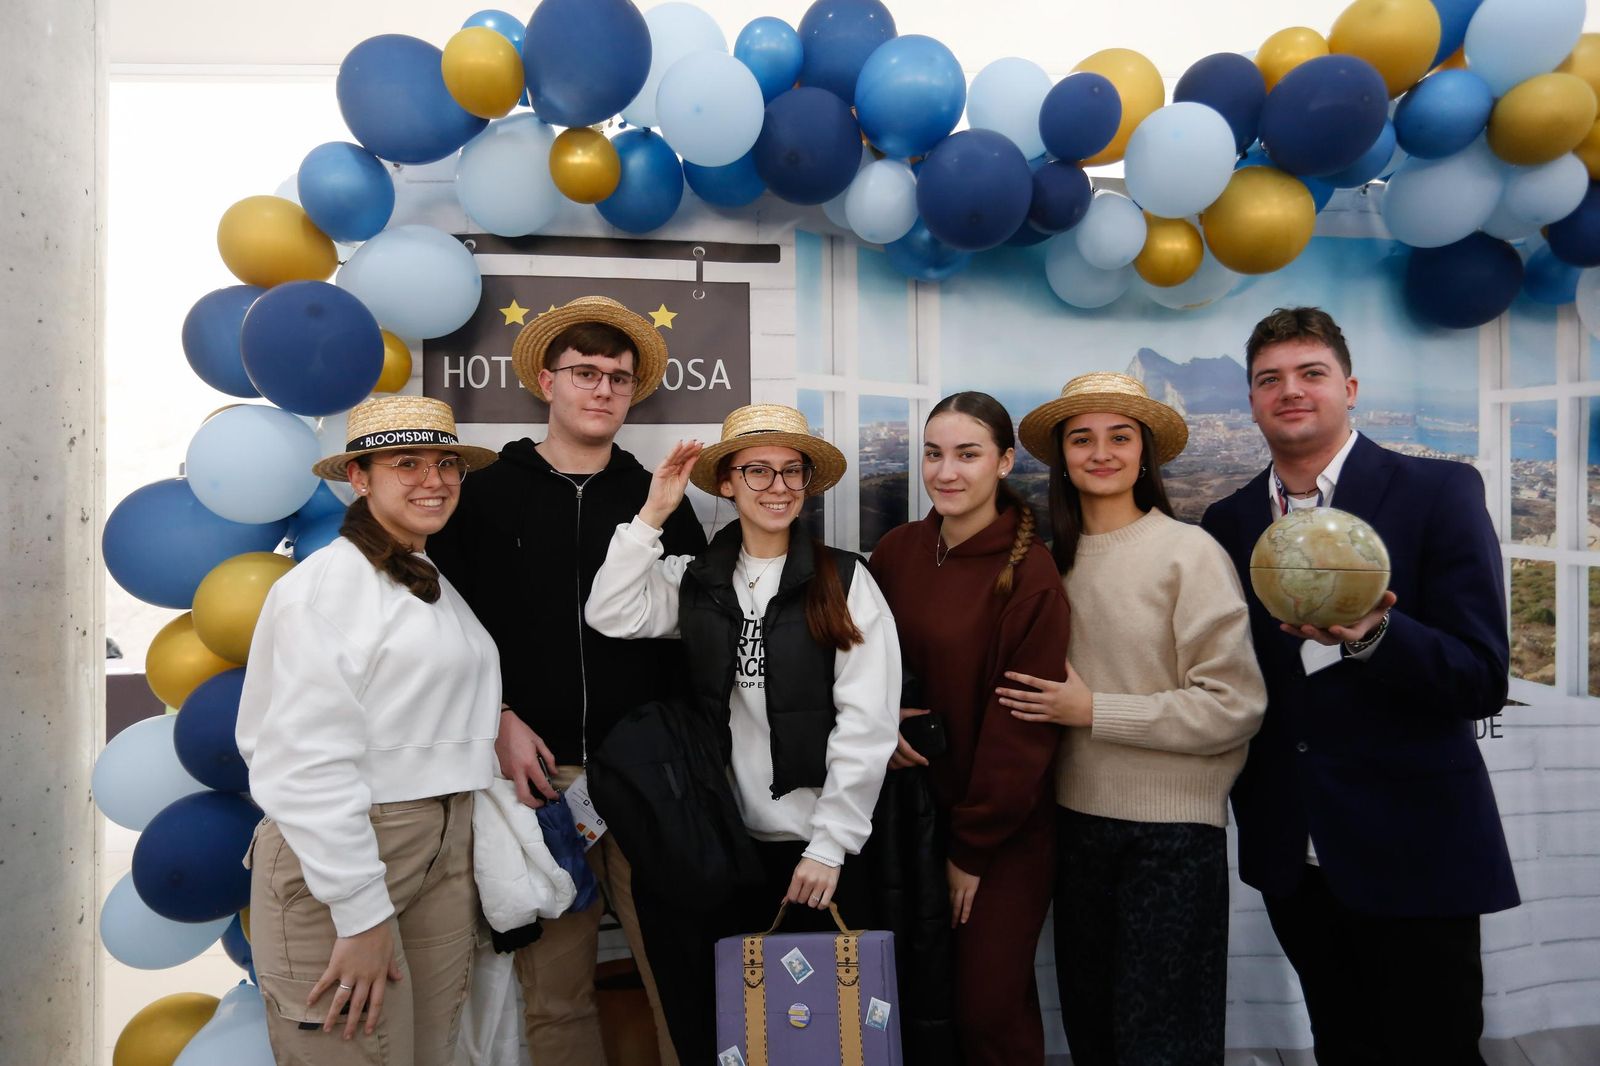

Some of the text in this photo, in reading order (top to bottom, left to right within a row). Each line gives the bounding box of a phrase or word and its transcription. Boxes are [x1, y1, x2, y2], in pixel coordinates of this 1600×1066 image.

[444, 355, 732, 391] HOT OSA
[365, 431, 434, 448] BLOOMSDAY
[742, 618, 763, 637] TH
[737, 656, 764, 677] ACE
